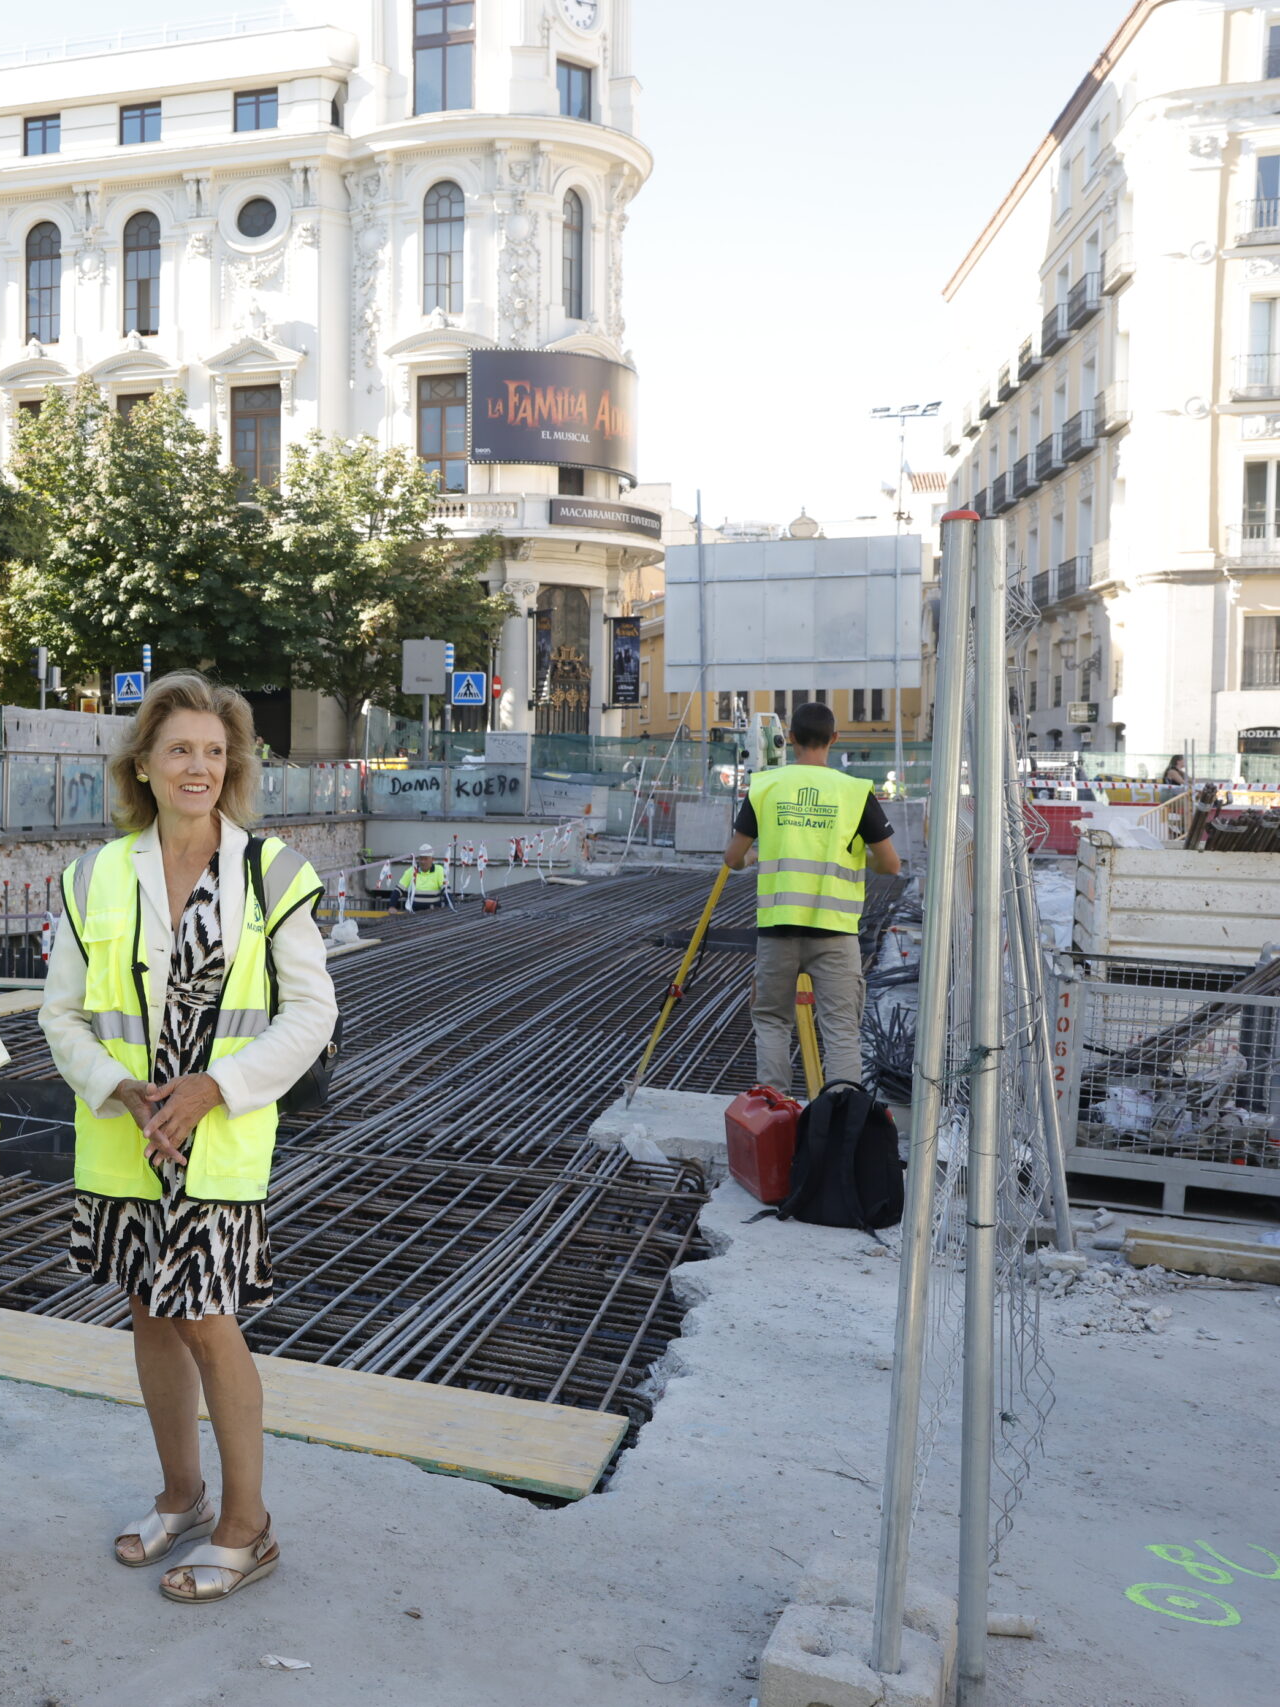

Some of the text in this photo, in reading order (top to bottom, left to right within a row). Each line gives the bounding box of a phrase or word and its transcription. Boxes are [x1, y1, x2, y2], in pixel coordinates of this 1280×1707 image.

[487, 398, 504, 418] LA
[541, 430, 590, 443] EL MUSICAL
[560, 507, 660, 530] MACABRAMENTE DIVERTIDO
[777, 805, 803, 813] MADRID
[804, 807, 833, 815] CENTRO
[805, 818, 826, 829] Azvi
